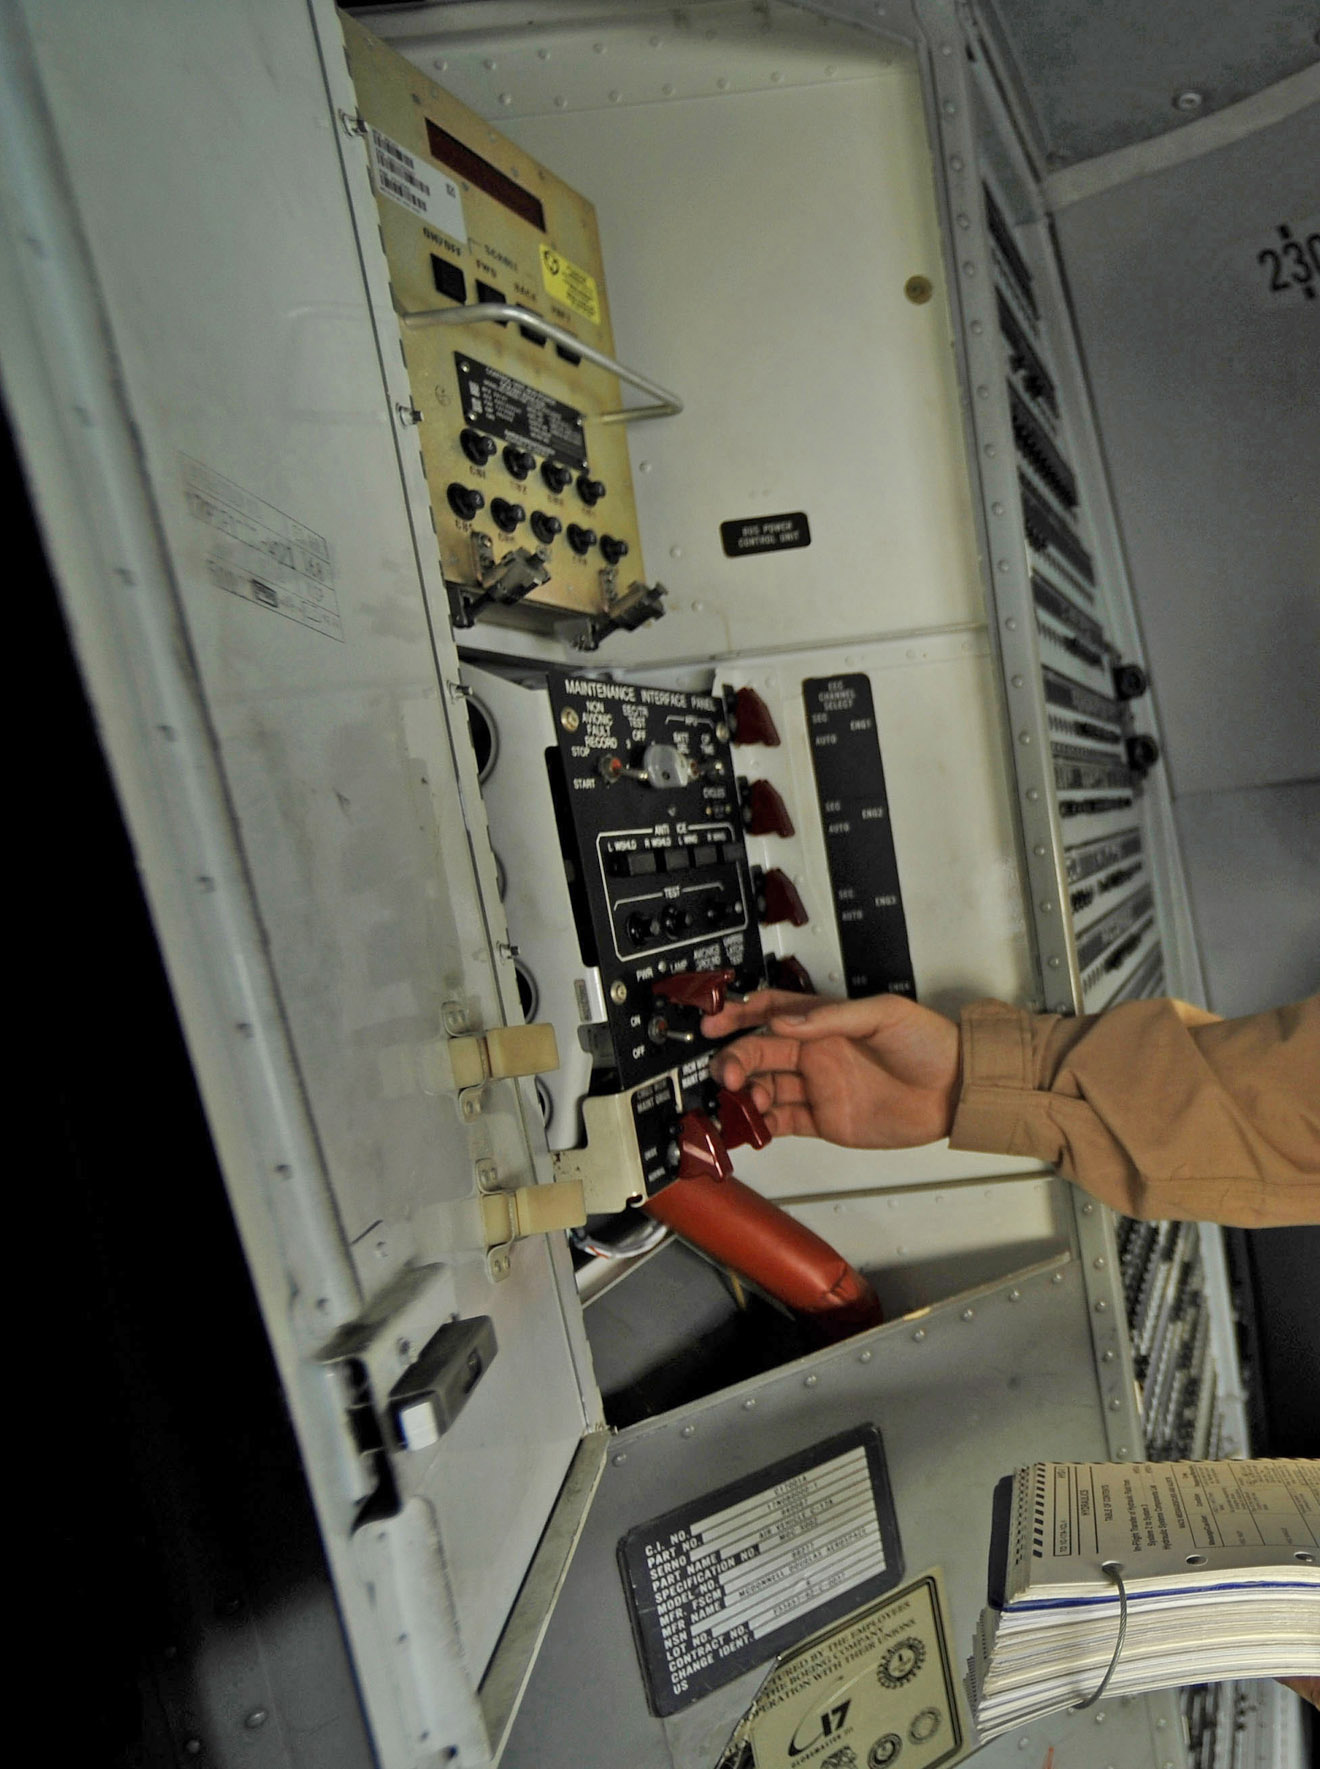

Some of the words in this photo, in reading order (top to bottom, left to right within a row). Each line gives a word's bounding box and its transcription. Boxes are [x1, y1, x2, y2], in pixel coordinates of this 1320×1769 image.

[763, 521, 792, 533] POWER
[738, 534, 776, 548] CONTROL
[565, 679, 636, 701] MAINTENANCE
[641, 690, 687, 708] INTERFACE
[691, 697, 716, 712] PANEL
[819, 689, 856, 701] CHANNEL
[586, 701, 604, 713] NON
[824, 700, 853, 711] SELECT
[582, 712, 613, 725] AVIONIC
[630, 717, 646, 728] TEST
[587, 725, 611, 737] FAULT
[632, 729, 646, 741] OFF
[585, 736, 618, 749] RECORD
[815, 733, 837, 746] AUTO
[571, 746, 590, 757] STOP
[574, 778, 595, 789] START
[655, 824, 670, 836] ANTI
[676, 822, 687, 834] ICE
[829, 823, 849, 834] AUTO
[664, 885, 680, 899] TEST
[842, 910, 863, 921] AUTO
[636, 966, 654, 982] PWR
[631, 1014, 641, 1027] ON
[633, 1045, 645, 1059] OFF
[1101, 1484, 1111, 1502] CONTENTS
[1080, 1489, 1090, 1516] HYDRAULICS
[1105, 1509, 1113, 1521] TABLE
[1143, 1506, 1152, 1521] System
[645, 1541, 665, 1556] C.I.
[670, 1530, 690, 1545] NO.
[1132, 1532, 1142, 1551] In-Flight
[1147, 1530, 1156, 1546] System
[1161, 1530, 1171, 1550] Hydraulic
[647, 1546, 676, 1568] PART
[682, 1537, 701, 1552] NO.
[650, 1555, 687, 1580] SERNO
[652, 1570, 681, 1592] PART
[686, 1553, 718, 1575] NAME
[655, 1557, 735, 1603] SPECIFICATION
[740, 1547, 759, 1561] NO.
[657, 1591, 695, 1614] MODEL
[700, 1579, 719, 1594] NO.
[659, 1608, 687, 1627] MFR.
[692, 1589, 722, 1610] FSCM
[662, 1620, 685, 1638] MFR
[690, 1601, 721, 1623] NAME
[664, 1630, 688, 1649] NSN
[666, 1643, 687, 1660] LOT
[692, 1633, 711, 1647] NO.
[768, 1656, 809, 1685] TURED
[811, 1650, 824, 1661] BY
[828, 1638, 849, 1654] THE
[851, 1601, 911, 1637] EMPLOYEES
[669, 1636, 725, 1672] CONTRACT
[730, 1625, 748, 1639] NO.
[789, 1657, 832, 1685] BOEING
[832, 1627, 883, 1658] COMPANY
[813, 1662, 843, 1681] WITH
[846, 1644, 876, 1663] THEIR
[878, 1618, 916, 1644] UNIONS
[671, 1654, 714, 1683] CHANGE
[719, 1635, 753, 1658] IDENT.
[673, 1680, 688, 1695] US
[821, 1700, 851, 1737] 17
